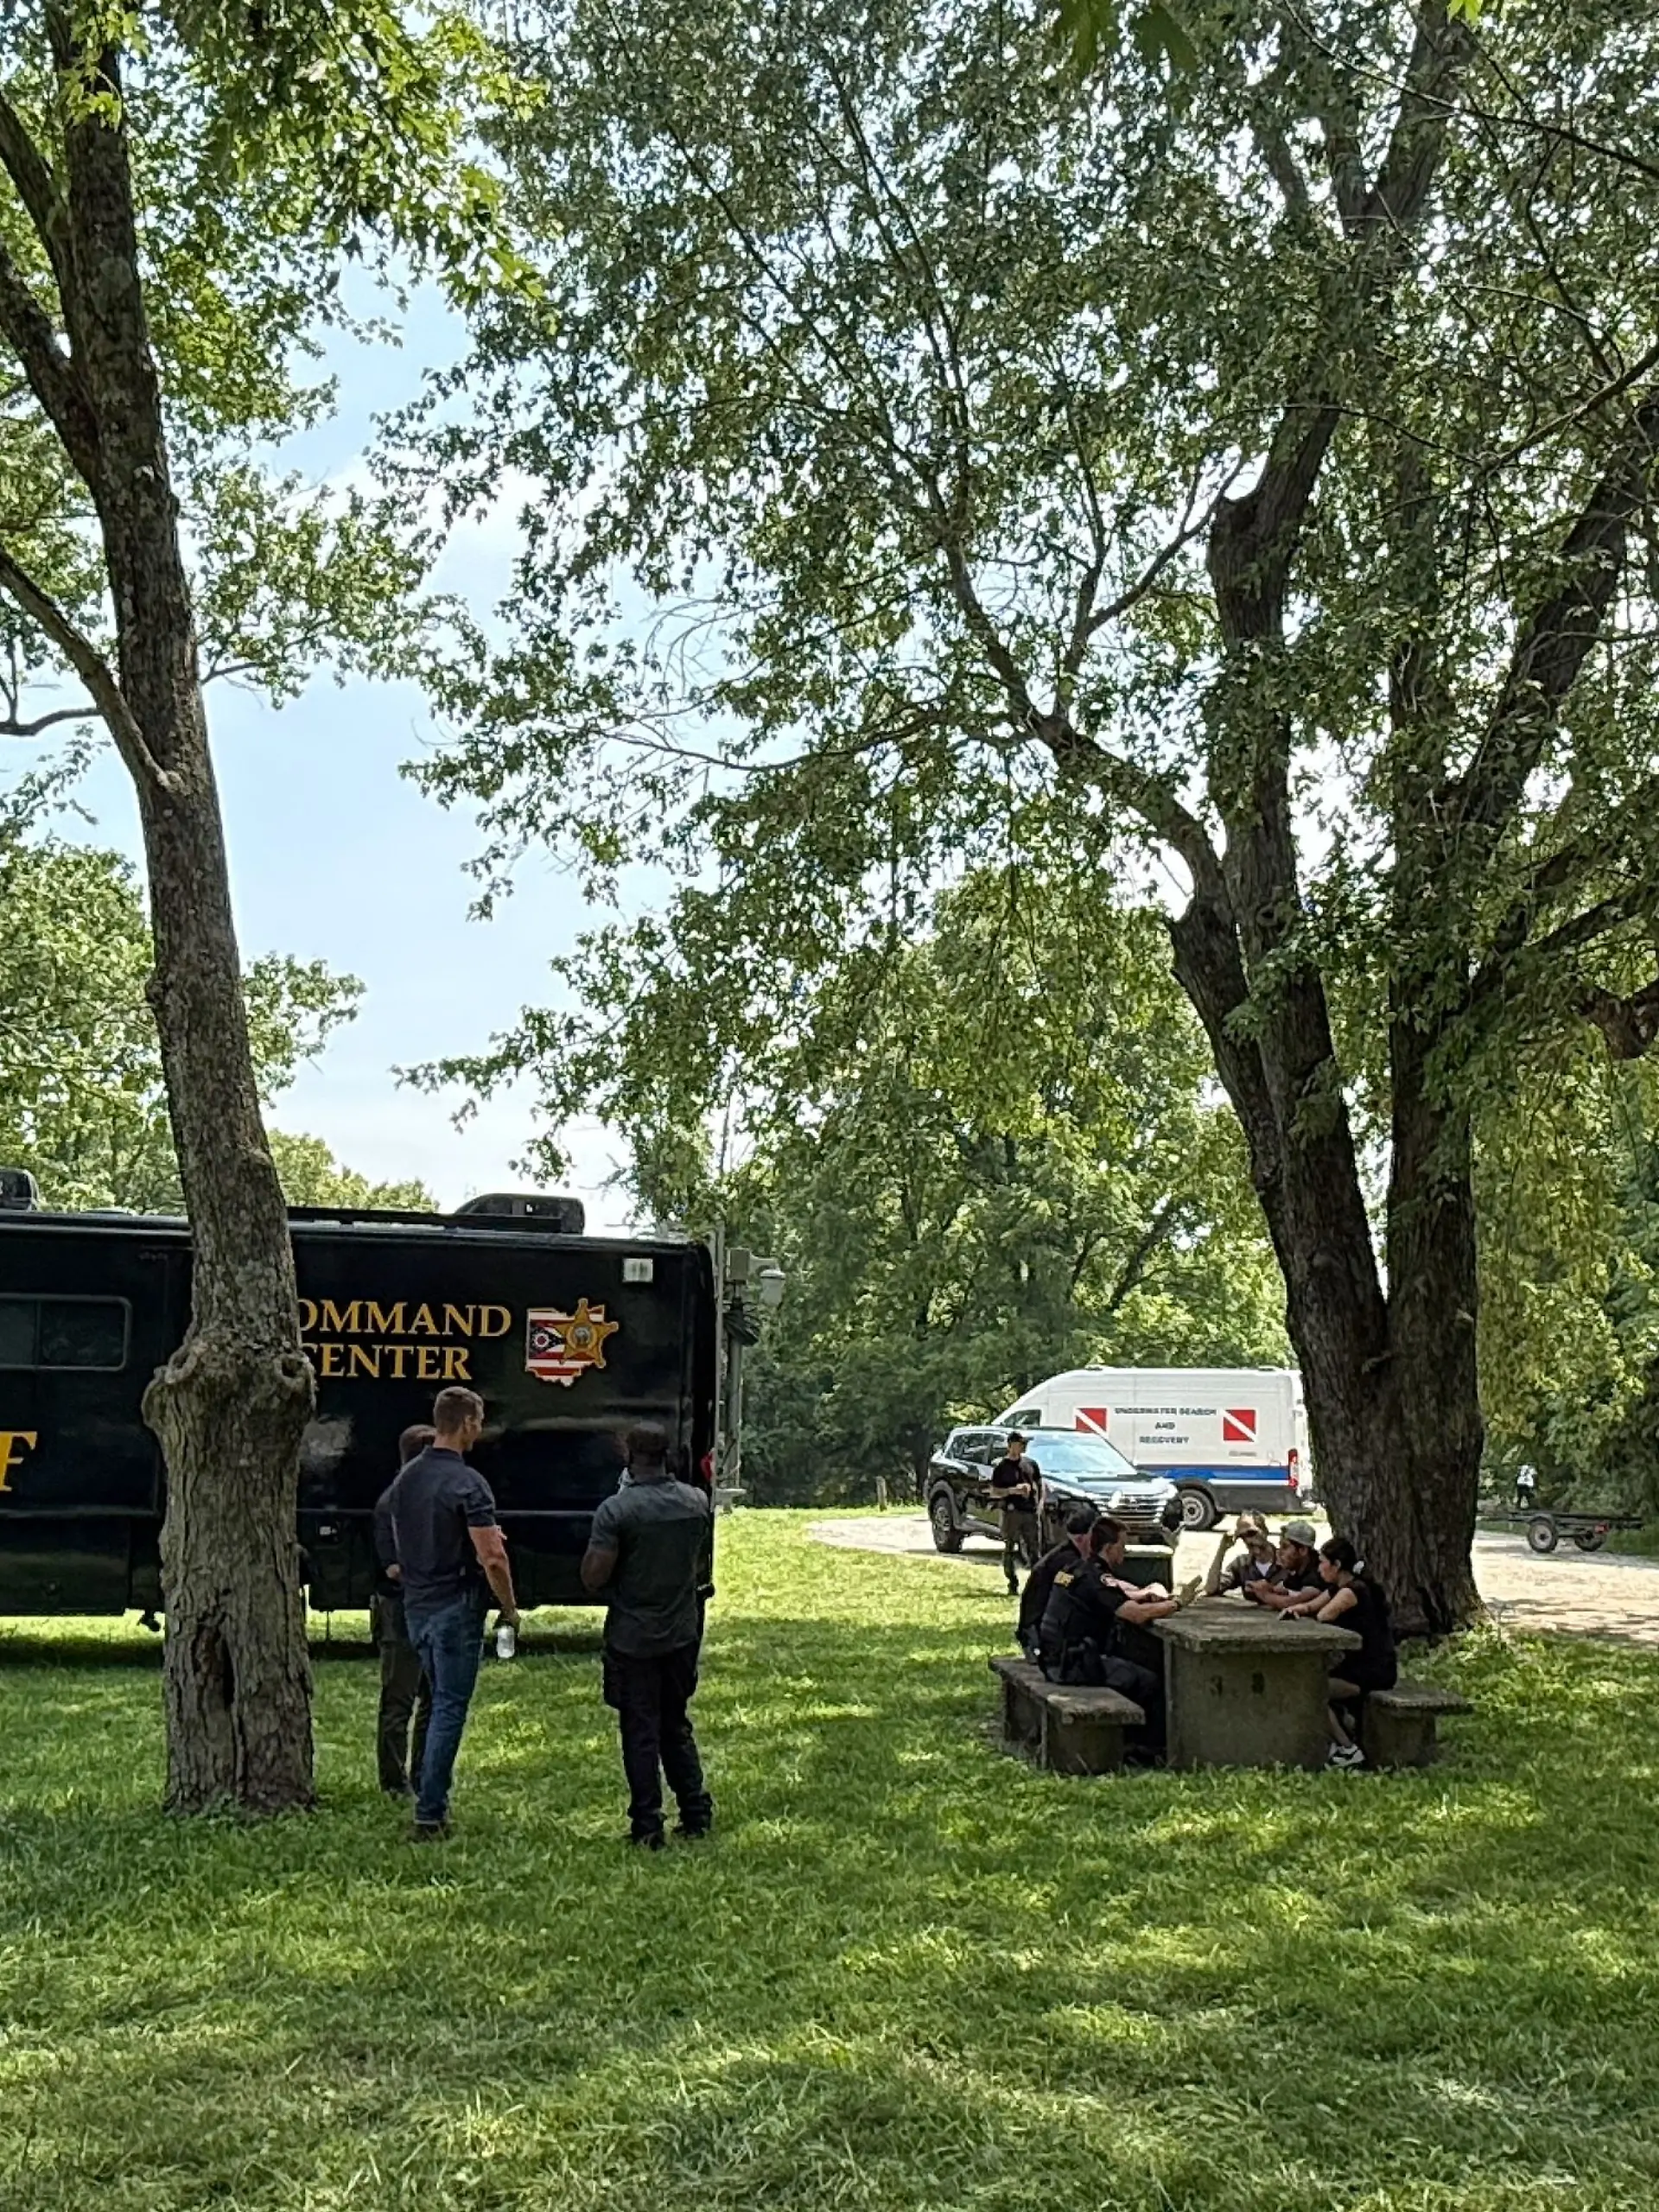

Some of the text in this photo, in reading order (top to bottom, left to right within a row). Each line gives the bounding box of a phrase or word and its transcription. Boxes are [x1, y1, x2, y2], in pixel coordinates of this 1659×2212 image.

[296, 1298, 512, 1337] OMMAND
[1179, 1408, 1217, 1416] SEARCH
[1154, 1421, 1176, 1430] AND
[1139, 1435, 1190, 1444] RECOVERY
